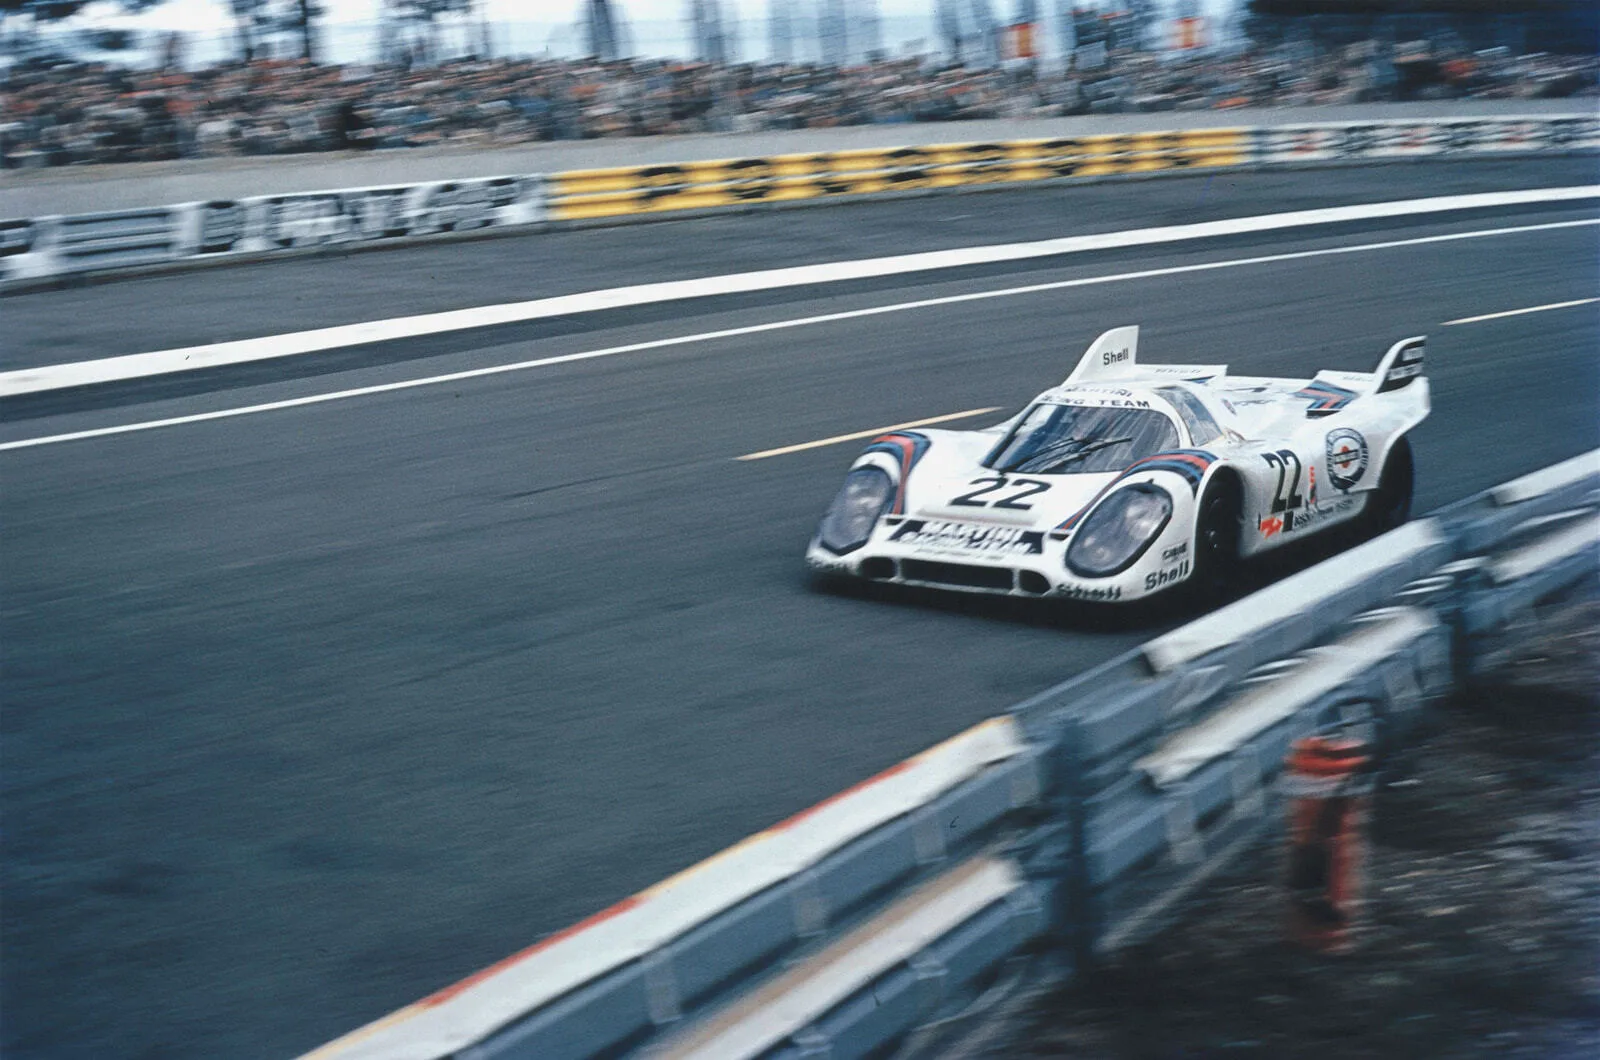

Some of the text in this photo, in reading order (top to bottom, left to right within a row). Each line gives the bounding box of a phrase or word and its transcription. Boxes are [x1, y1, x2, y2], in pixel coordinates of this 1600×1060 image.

[1103, 348, 1129, 366] Shell
[1099, 399, 1151, 409] TEAM
[949, 477, 1052, 511] 22
[1259, 449, 1302, 514] 22
[1144, 559, 1189, 590] Shell
